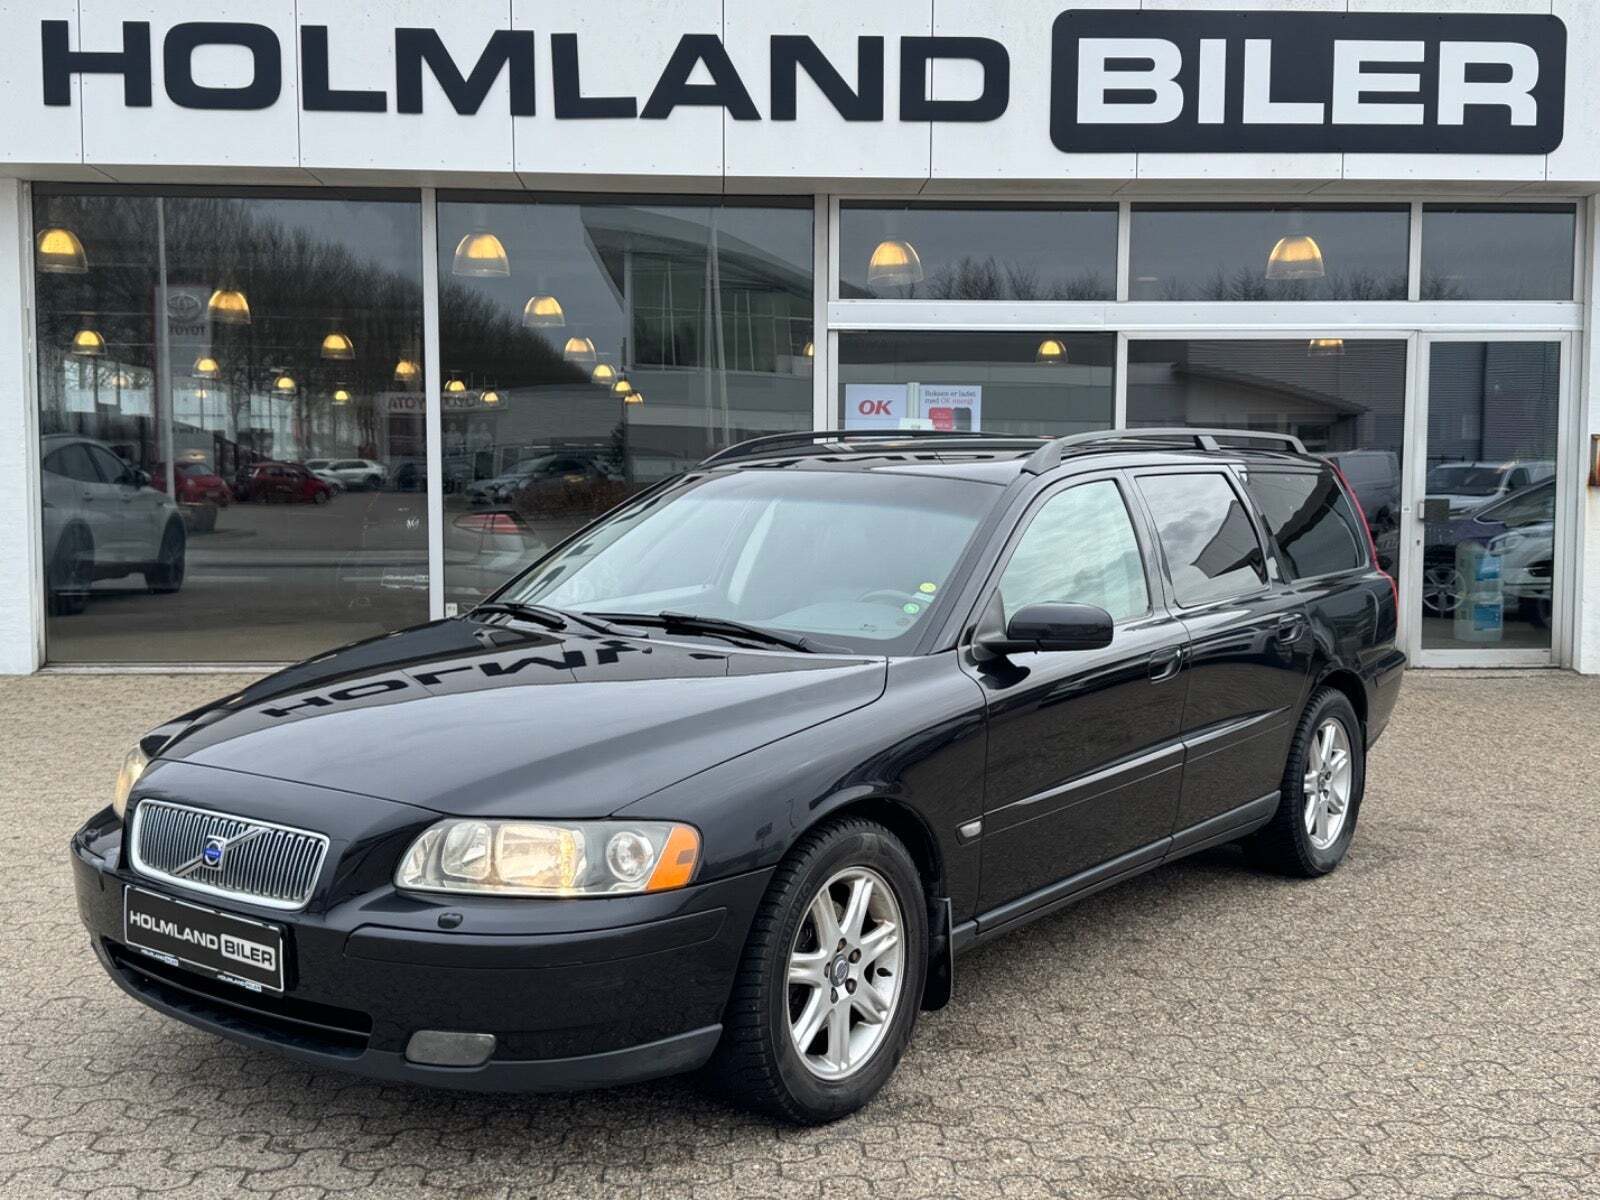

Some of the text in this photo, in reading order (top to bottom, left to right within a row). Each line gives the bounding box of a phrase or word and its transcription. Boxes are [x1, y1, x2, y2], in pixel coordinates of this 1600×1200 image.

[42, 20, 1539, 127] HOLMLAND BILER
[858, 399, 893, 416] OK
[129, 910, 273, 967] HOLMLAND BILER
